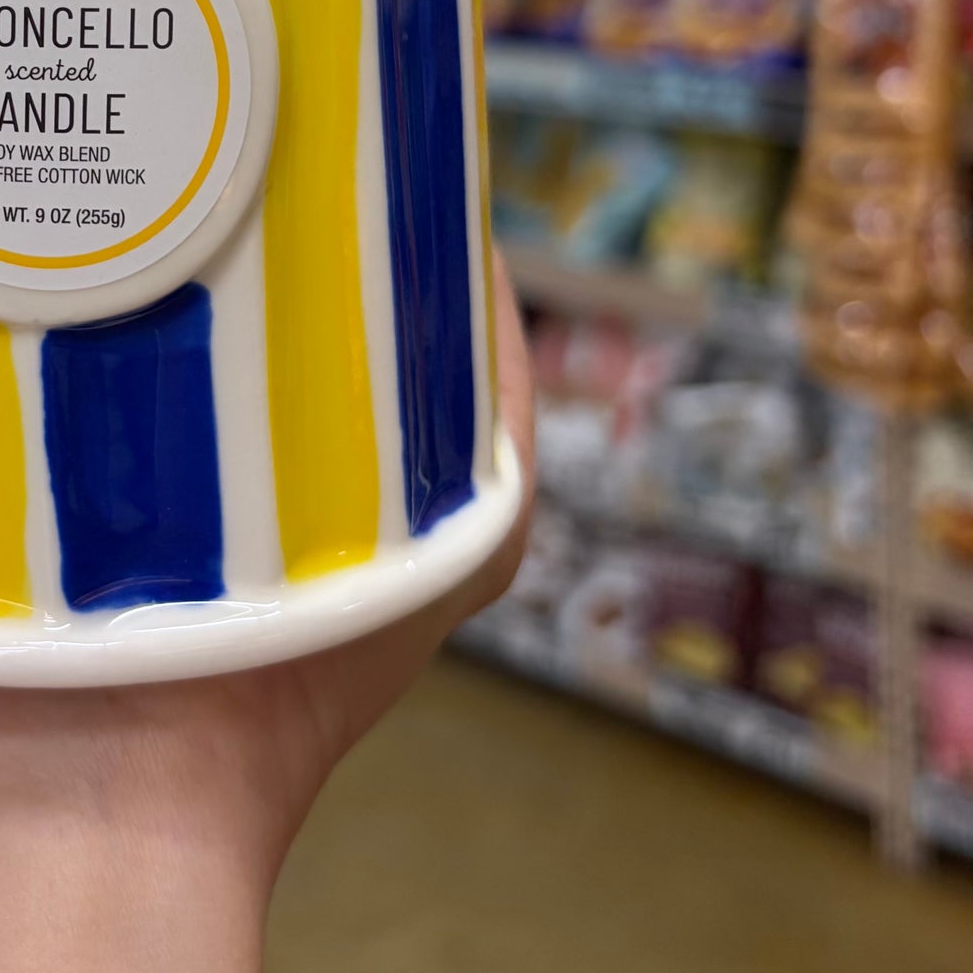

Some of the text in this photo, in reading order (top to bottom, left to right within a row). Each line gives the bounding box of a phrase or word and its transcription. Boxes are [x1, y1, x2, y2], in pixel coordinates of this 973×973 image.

[4, 57, 98, 82] scented
[19, 144, 54, 162] WAX
[58, 146, 111, 163] BLEND
[37, 167, 102, 185] COTTON
[105, 168, 146, 185] WICK
[2, 206, 30, 223] WT.
[35, 207, 46, 224] 9
[50, 208, 72, 225] OZ
[75, 208, 126, 229] (255g)
